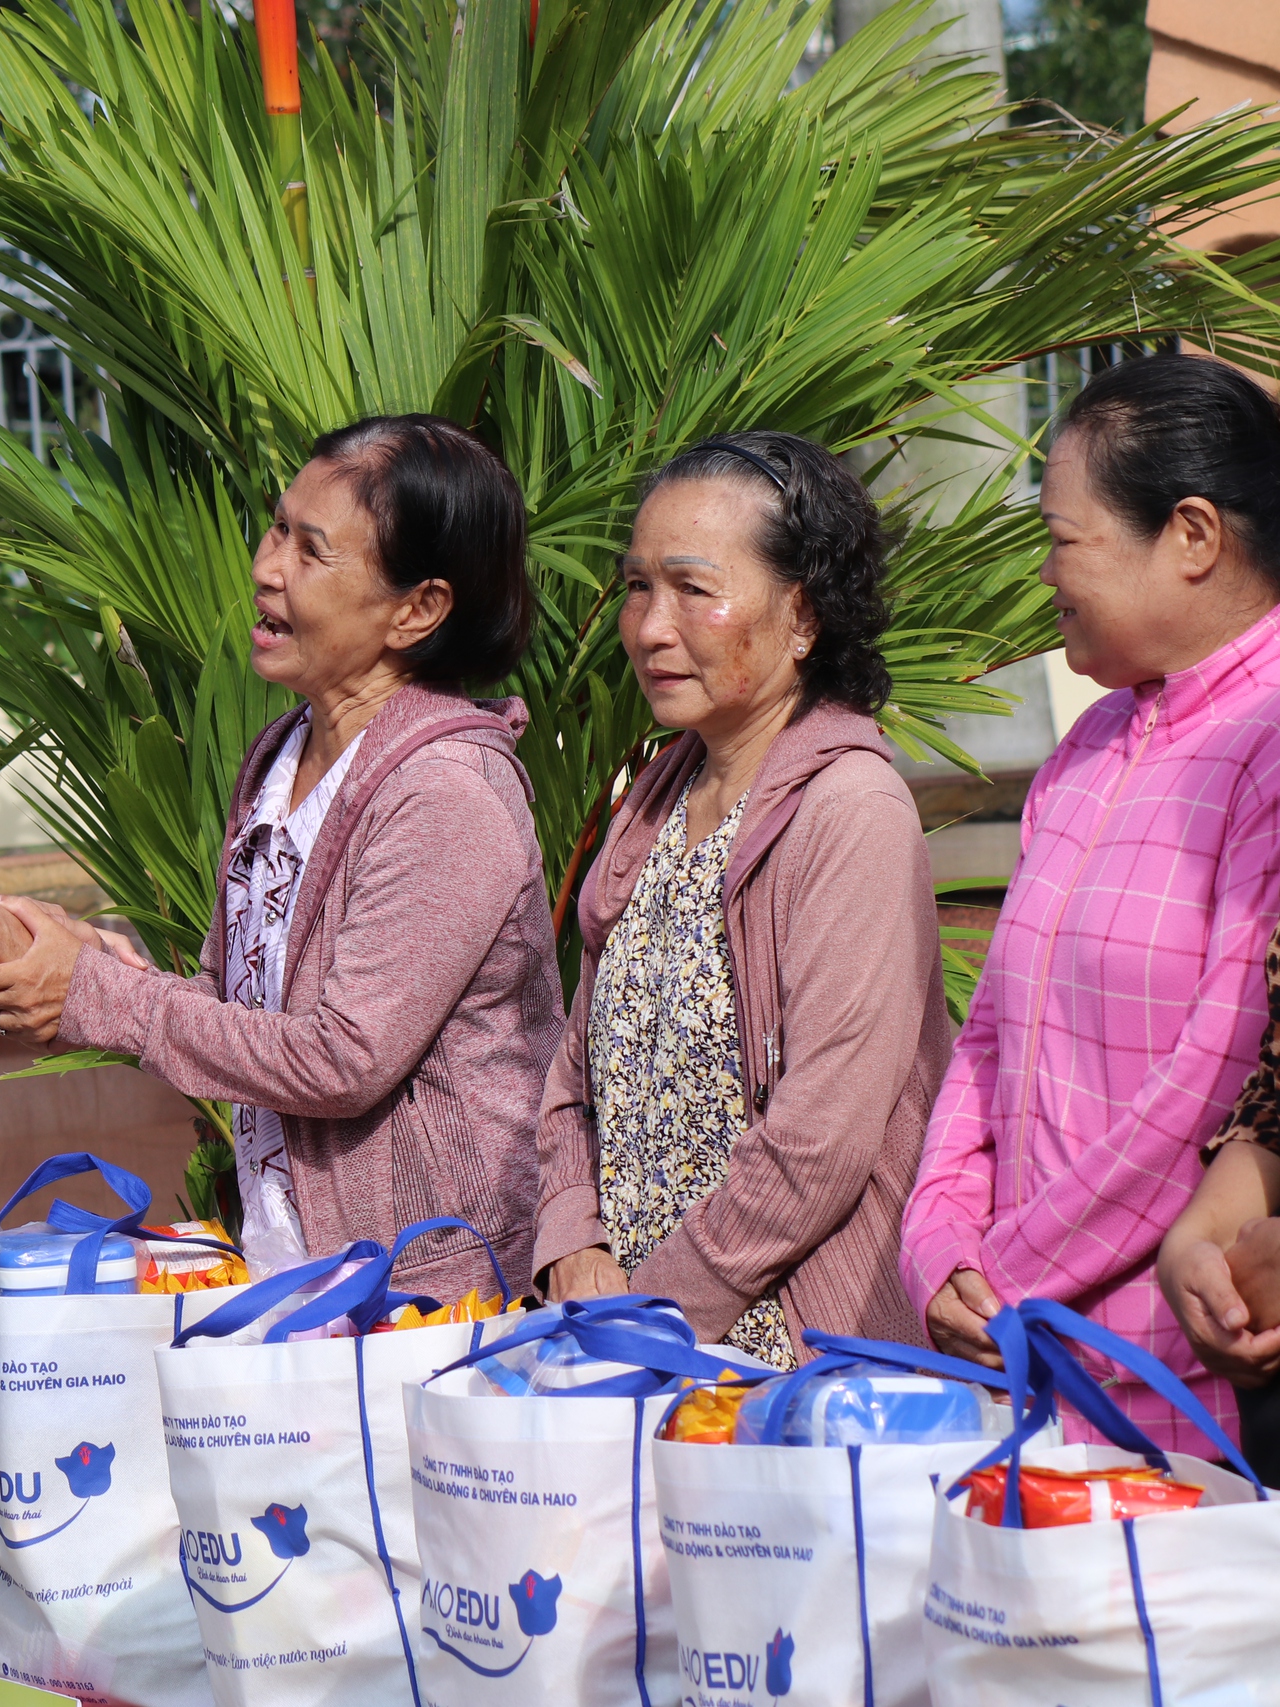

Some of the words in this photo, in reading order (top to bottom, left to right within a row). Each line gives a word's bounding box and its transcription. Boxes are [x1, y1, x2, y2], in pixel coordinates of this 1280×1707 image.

[2, 1360, 27, 1374] ĐÀO
[30, 1361, 58, 1375] TẠO
[0, 1379, 7, 1391] &
[8, 1376, 62, 1391] CHUYÊN
[65, 1377, 90, 1388] GIA
[92, 1374, 126, 1386] HAIO
[174, 1418, 200, 1430] TNHH
[201, 1414, 221, 1429] ĐÀO
[223, 1415, 247, 1430] TẠO
[176, 1434, 197, 1450] ĐỘNG
[198, 1436, 205, 1448] &
[206, 1432, 251, 1448] CHUYÊN
[254, 1432, 276, 1446] GIA
[278, 1431, 311, 1445] HAIO
[422, 1454, 437, 1472] CÔNG
[437, 1461, 449, 1475] TY
[449, 1463, 473, 1479] TNHH
[473, 1465, 489, 1482] ĐÀO
[491, 1469, 515, 1486] TẠO
[433, 1479, 446, 1494] LAO
[446, 1481, 470, 1499] ĐỘNG
[471, 1487, 478, 1500] &
[479, 1488, 518, 1504] CHUYÊN
[520, 1492, 540, 1506] GIA
[543, 1493, 578, 1507] HAIO
[22, 1510, 43, 1520] thai
[675, 1520, 685, 1534] TY
[686, 1522, 713, 1537] TNHH
[714, 1521, 736, 1538] ĐÀO
[737, 1525, 762, 1541] TẠO
[685, 1540, 713, 1560] ĐỘNG
[715, 1545, 724, 1558] &
[724, 1543, 772, 1559] CHUYÊN
[773, 1546, 792, 1560] GIA
[793, 1547, 814, 1562] HAIO
[230, 1572, 247, 1583] thai
[35, 1589, 59, 1604] việc
[61, 1583, 94, 1600] nước
[95, 1577, 134, 1597] ngoài
[966, 1600, 985, 1619] ĐÀO
[987, 1607, 1005, 1626] TẠO
[971, 1627, 1012, 1647] CHUYÊN
[1013, 1635, 1037, 1648] GIA
[1038, 1634, 1079, 1648] HAIO
[252, 1652, 277, 1669] việc
[279, 1649, 308, 1665] nước
[310, 1640, 348, 1663] ngoài
[9, 1668, 20, 1678] 090
[20, 1671, 31, 1682] 188
[31, 1675, 46, 1686] 1963
[49, 1679, 62, 1688] 090
[64, 1681, 76, 1690] 188
[76, 1681, 95, 1691] 3163
